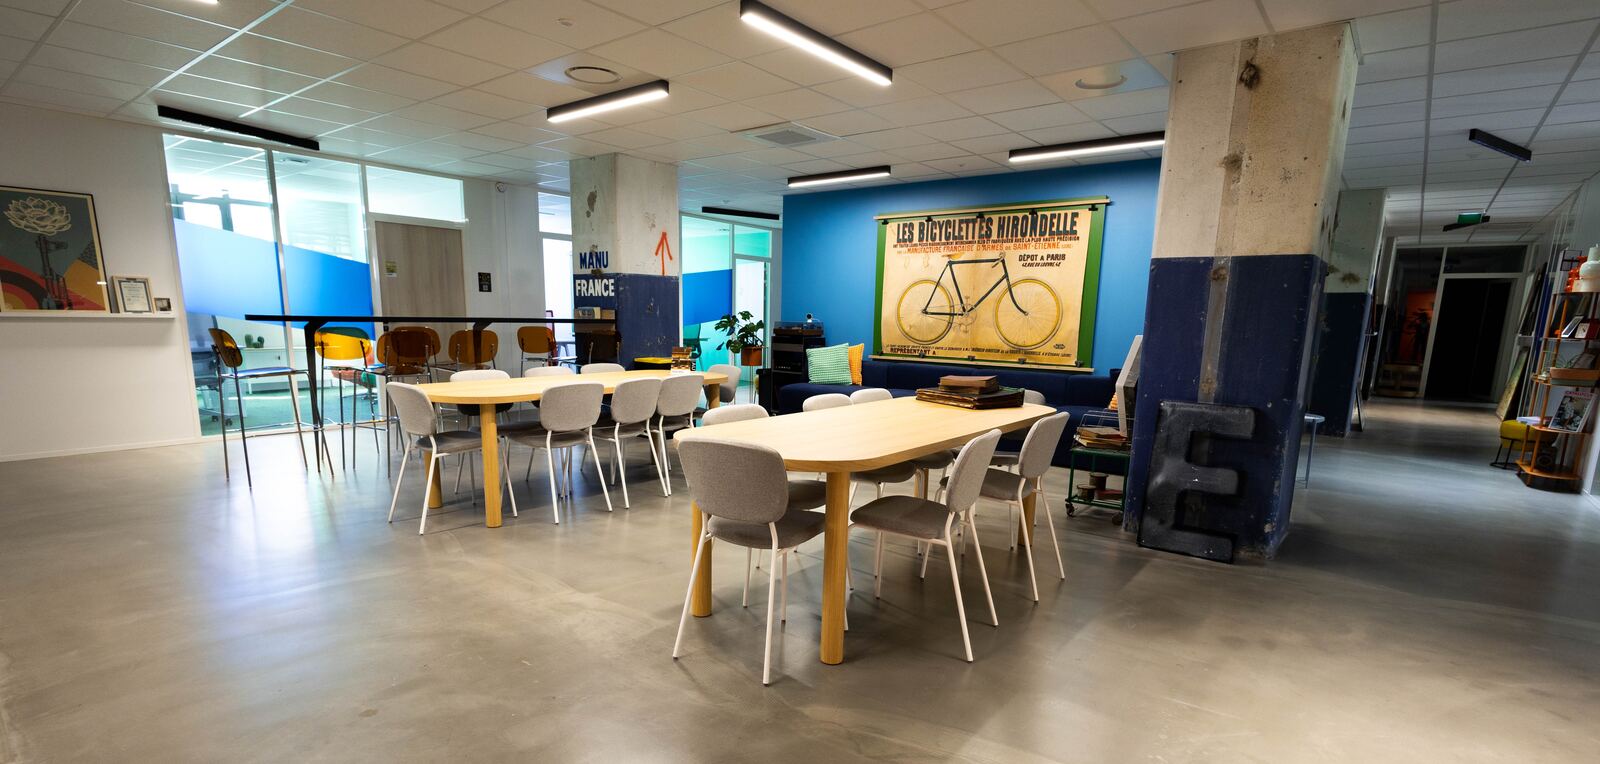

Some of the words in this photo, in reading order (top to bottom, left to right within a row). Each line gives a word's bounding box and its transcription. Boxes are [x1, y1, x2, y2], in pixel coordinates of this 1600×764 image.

[896, 222, 914, 243] LES
[918, 216, 994, 242] BICYCLETTES
[997, 212, 1079, 239] HIRONDELLE
[580, 251, 608, 269] MANU
[576, 278, 614, 296] FRANCE
[1136, 400, 1255, 564] E
